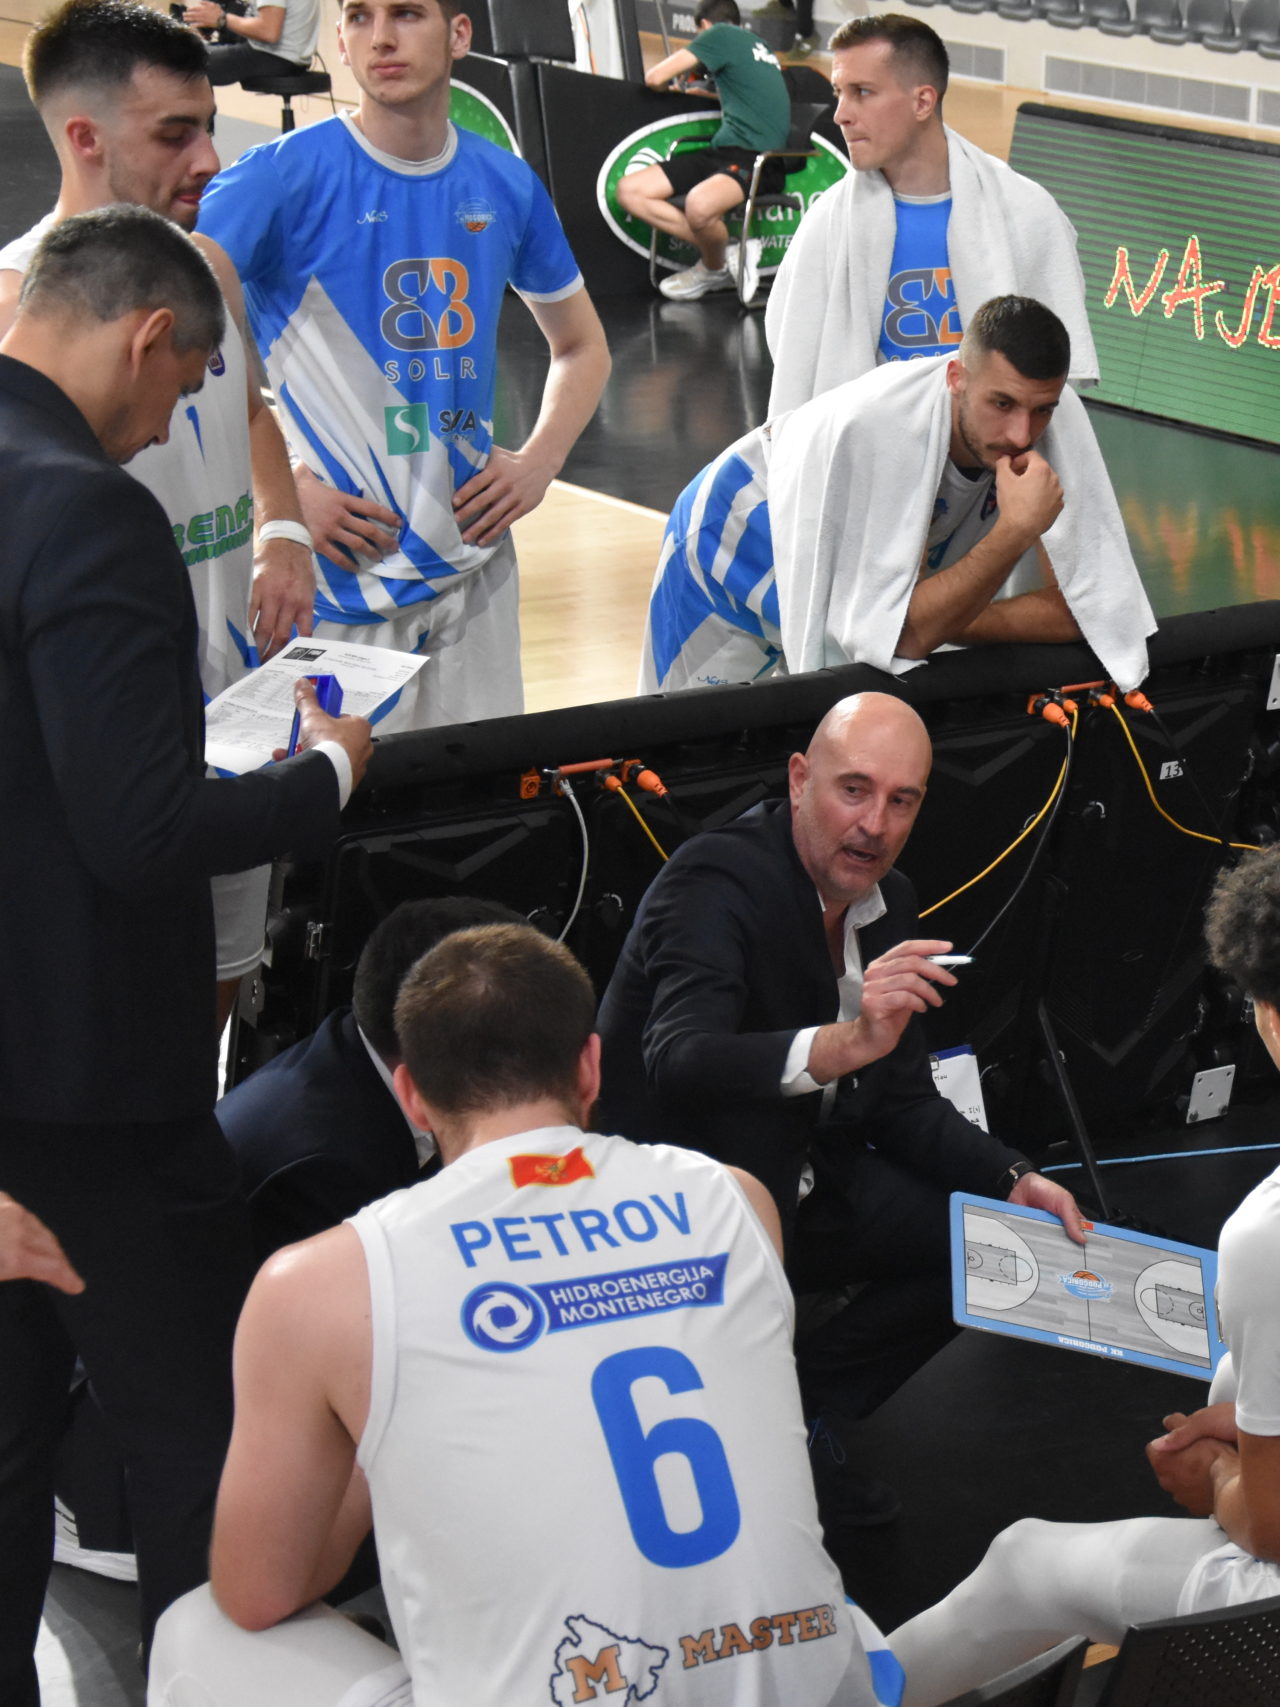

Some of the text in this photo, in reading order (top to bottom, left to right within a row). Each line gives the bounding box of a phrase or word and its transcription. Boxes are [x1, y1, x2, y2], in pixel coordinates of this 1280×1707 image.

[384, 356, 478, 384] SOLR
[449, 1191, 692, 1268] PETROV
[549, 1265, 715, 1306] HIDROENERGIJA
[559, 1282, 708, 1325] MONTENEGRO
[590, 1345, 741, 1569] 6
[564, 1603, 837, 1704] M MASTER
